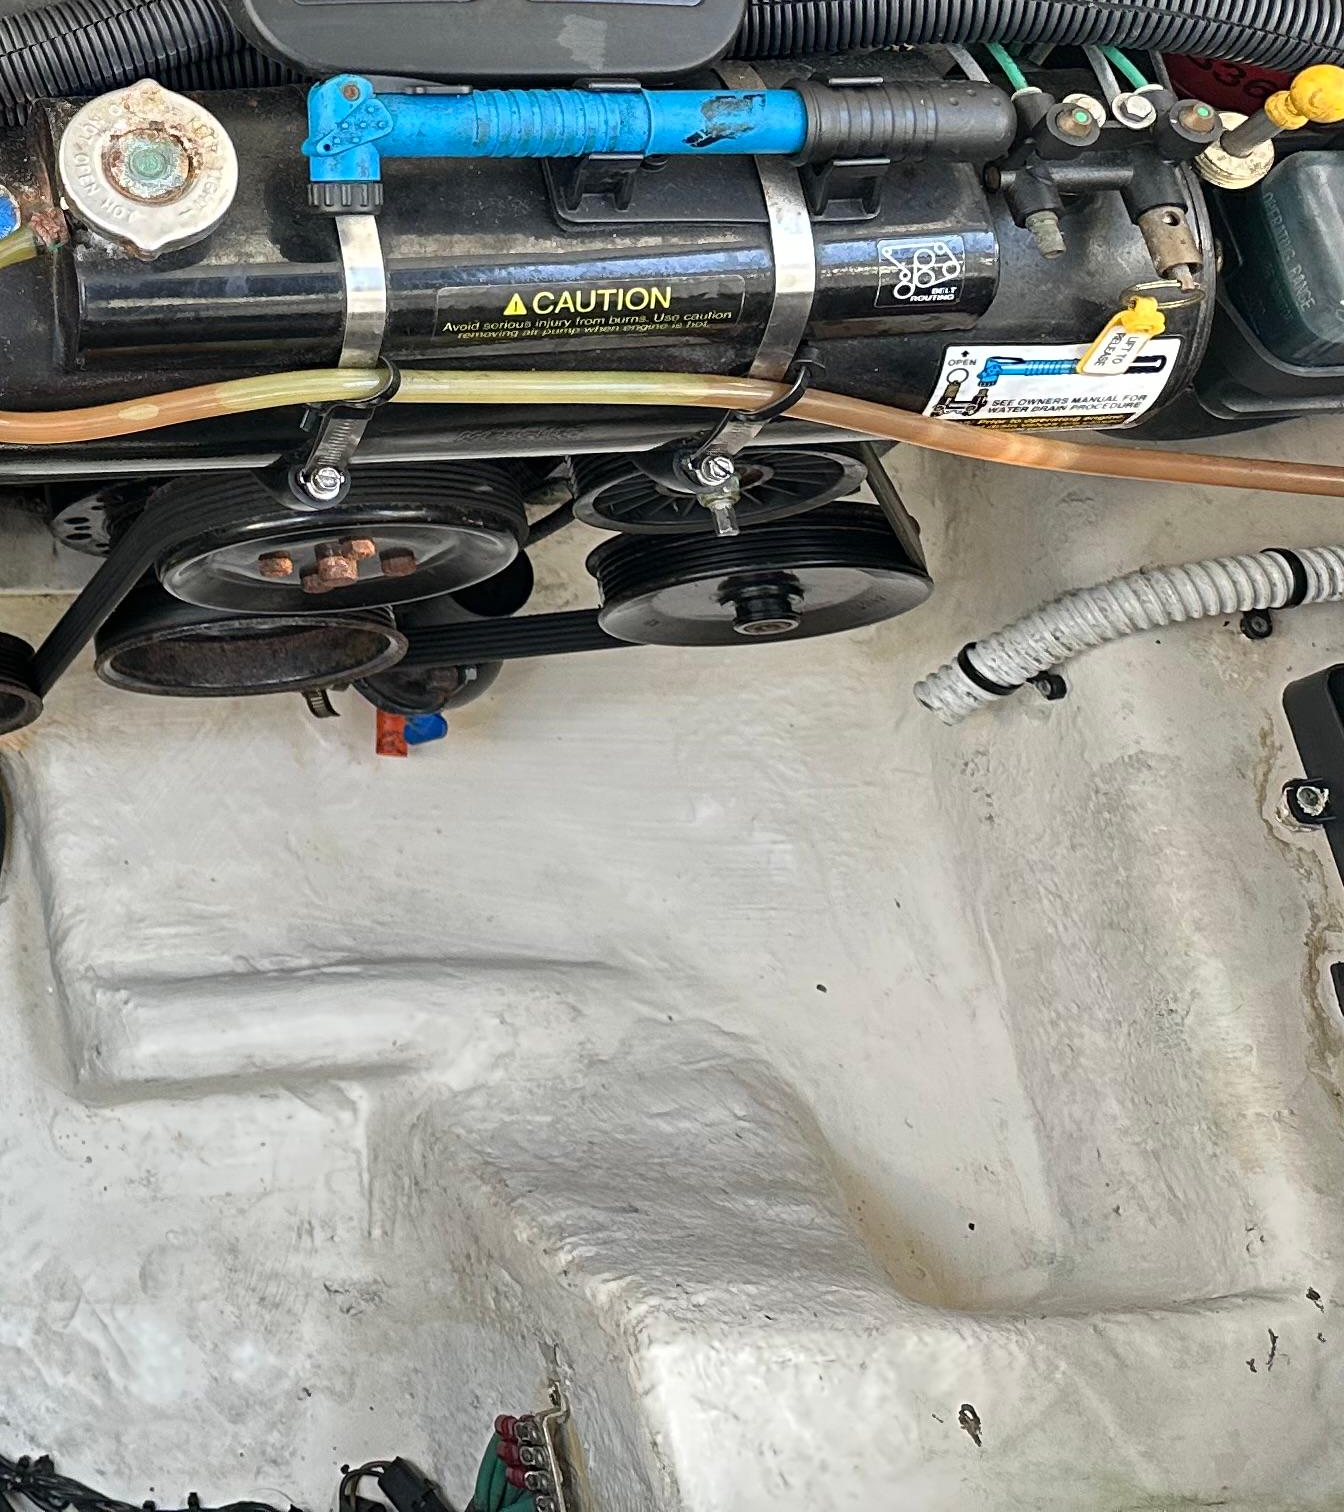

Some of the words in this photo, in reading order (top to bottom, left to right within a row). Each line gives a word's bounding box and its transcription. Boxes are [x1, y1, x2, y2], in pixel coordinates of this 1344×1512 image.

[1285, 264, 1316, 312] RANGE
[532, 287, 672, 315] CAUTION
[909, 294, 955, 302] ROUTING
[443, 321, 479, 332] Avoid
[483, 320, 531, 330] serious
[535, 318, 572, 330] injury
[574, 316, 605, 326] from
[654, 312, 680, 322] Use
[684, 310, 732, 320] caution
[458, 329, 519, 340] removing
[522, 328, 539, 337] air
[542, 327, 581, 338] pump
[583, 325, 620, 334] when
[622, 322, 669, 334] engine
[671, 321, 682, 329] is
[1094, 332, 1127, 367] RELEASE
[1125, 337, 1140, 353] LIFT
[1112, 354, 1127, 365] TO
[988, 406, 1028, 414] WATER
[1072, 402, 1142, 411] PROCEDURE
[1020, 398, 1069, 406] OWNERS
[1072, 395, 1119, 403] MANUAL
[1122, 394, 1148, 402] FOR
